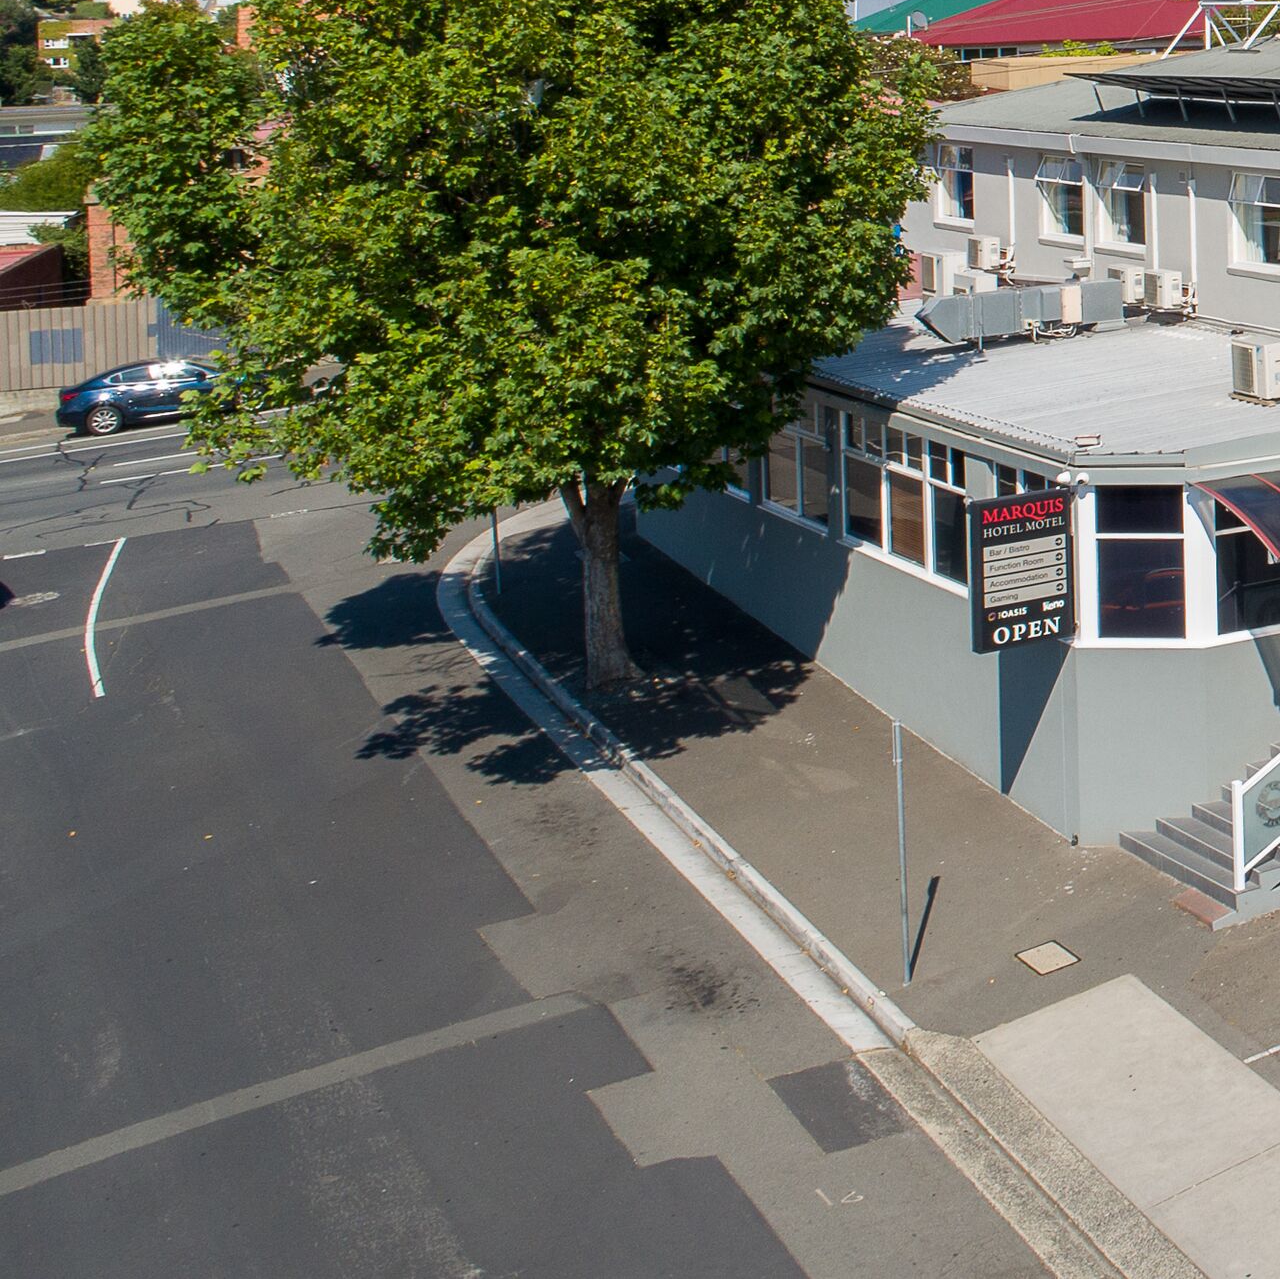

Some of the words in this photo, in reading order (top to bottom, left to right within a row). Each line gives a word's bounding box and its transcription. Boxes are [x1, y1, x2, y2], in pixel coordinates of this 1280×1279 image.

[982, 498, 1064, 524] MARQUIS
[983, 523, 1023, 539] HOTEL
[1025, 516, 1065, 531] MOTEL
[989, 548, 1002, 557] Bar
[1009, 544, 1030, 554] Bistro
[990, 561, 1021, 572] Function
[1022, 557, 1045, 567] Room
[990, 572, 1049, 588] Accommodation
[990, 592, 1019, 603] Gaming
[993, 616, 1061, 644] OPEN
